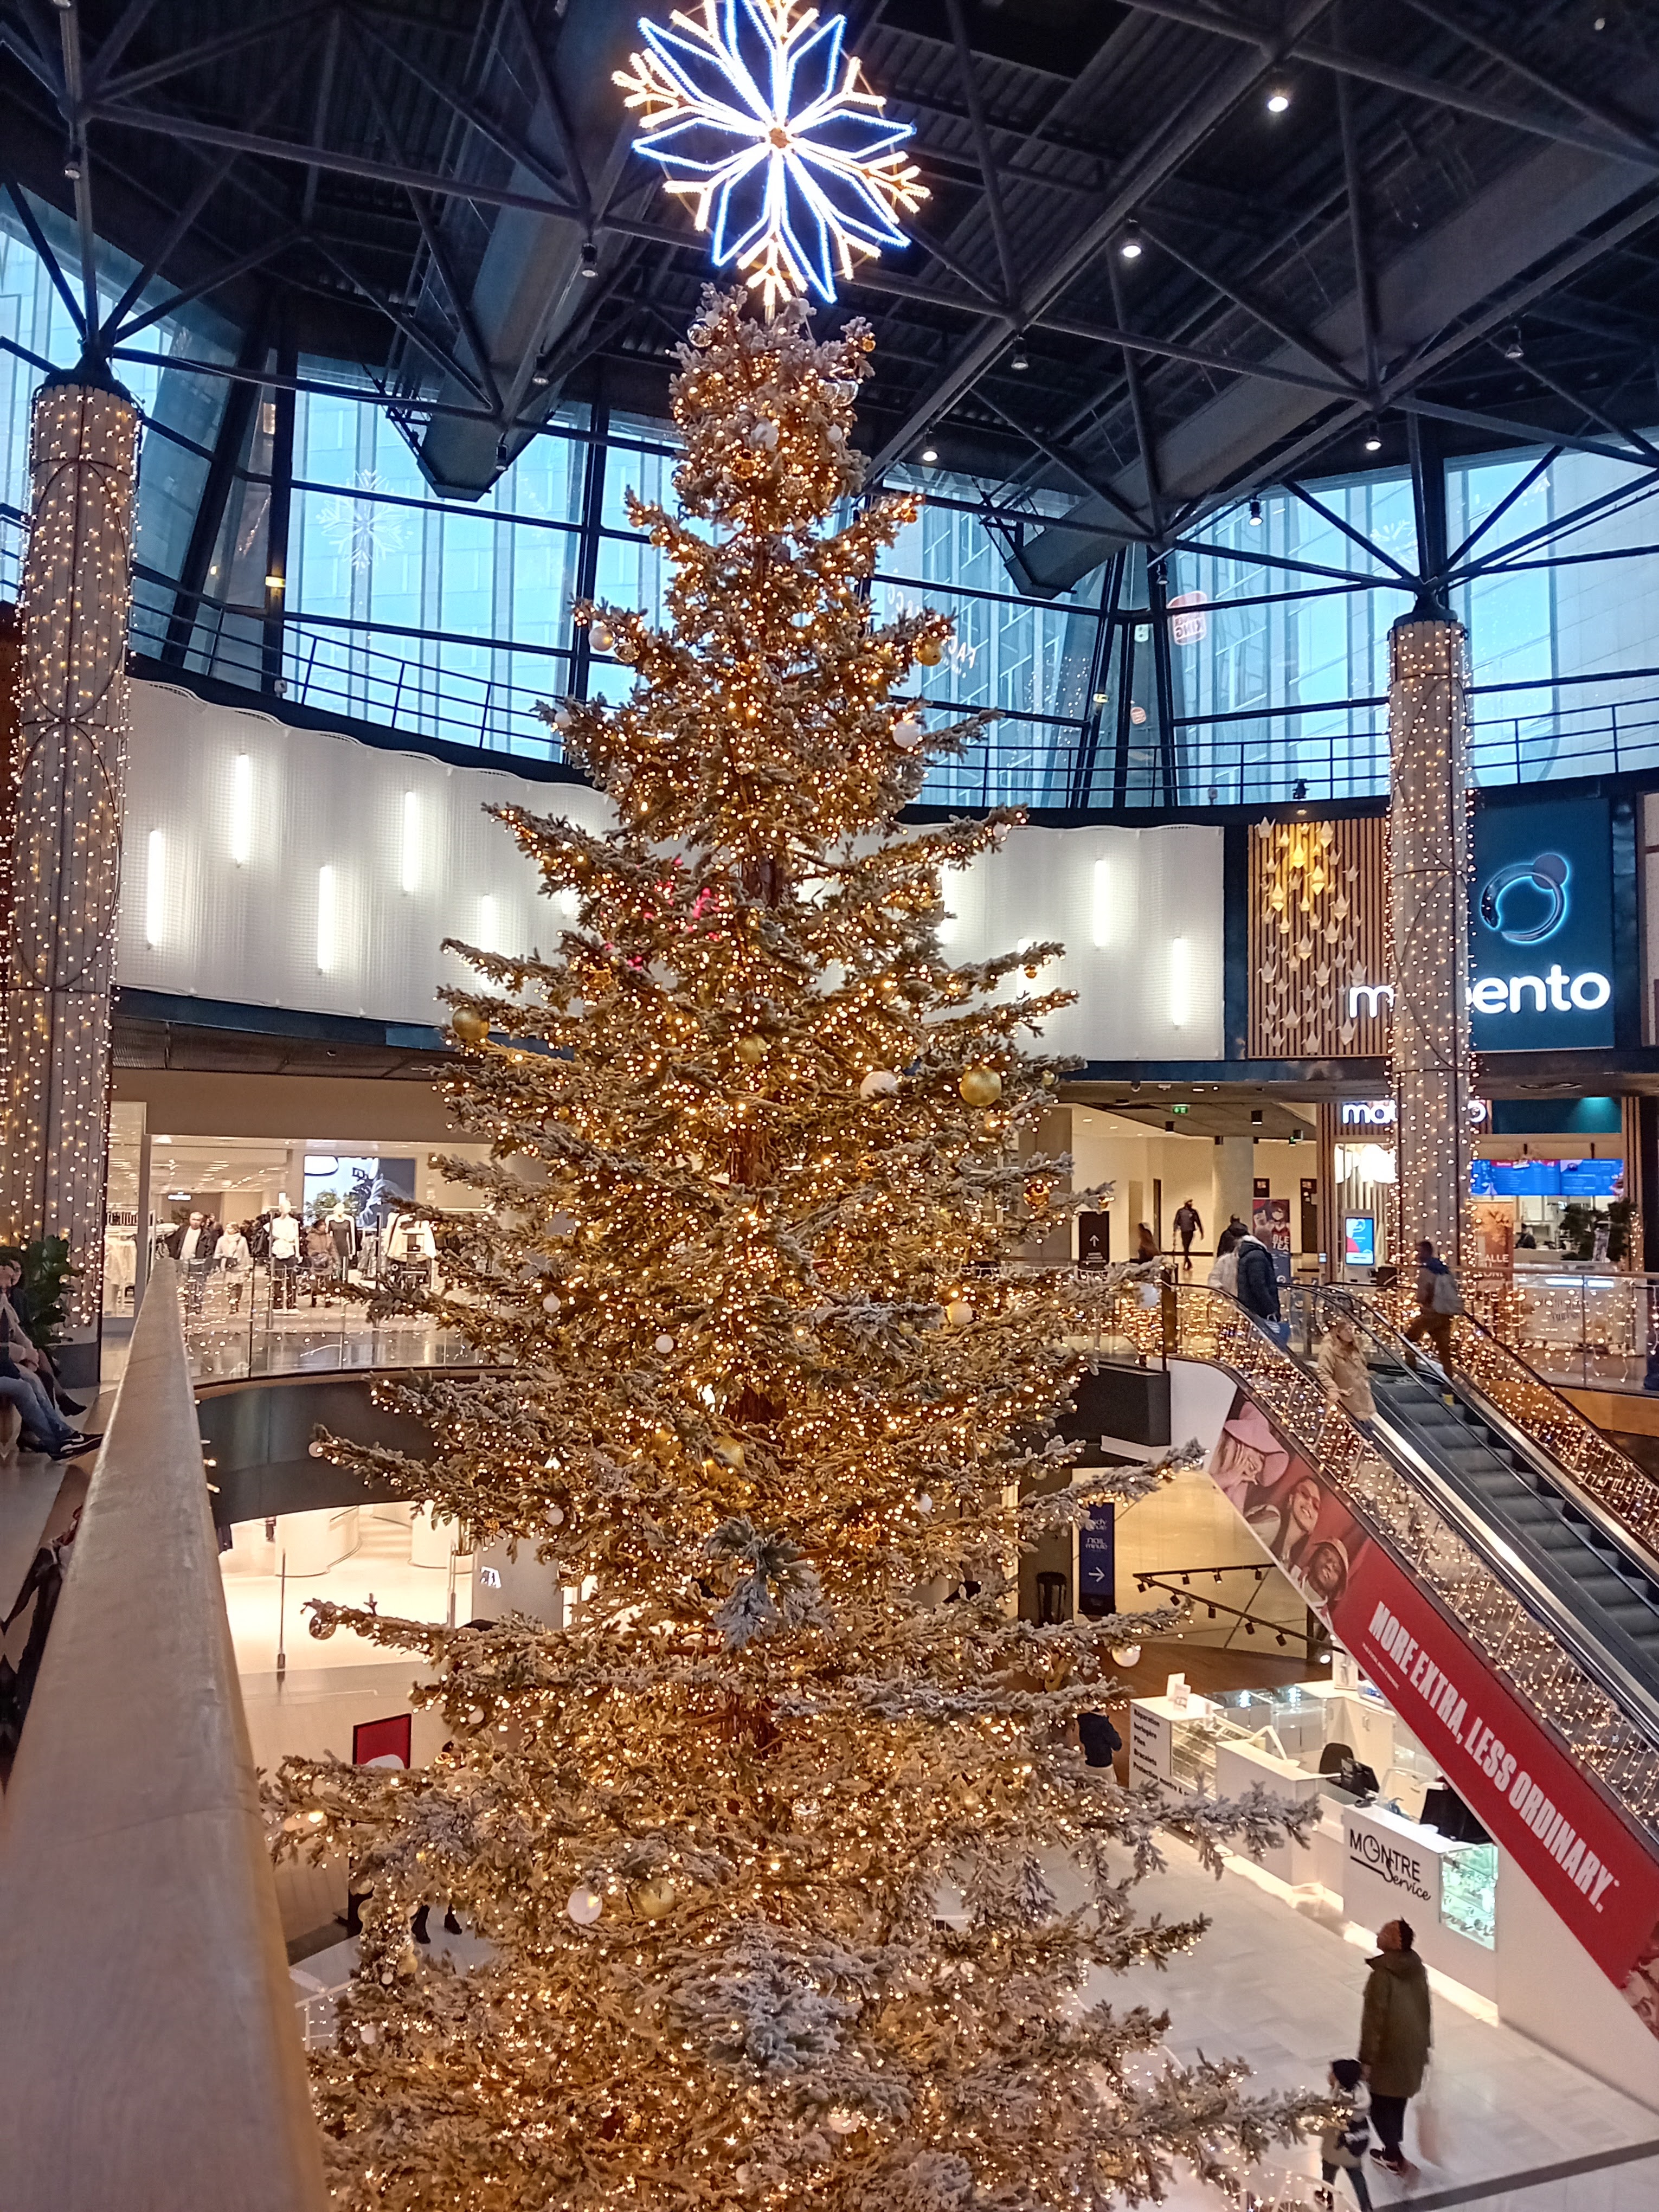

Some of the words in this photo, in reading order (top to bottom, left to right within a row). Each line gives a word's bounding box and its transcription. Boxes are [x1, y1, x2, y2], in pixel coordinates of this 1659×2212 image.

[1368, 1600, 1419, 1675] MORE
[1410, 1650, 1468, 1745] EXTRA,
[1464, 1716, 1517, 1792] LESS
[1350, 1829, 1421, 1882] MONTRE
[1382, 1858, 1432, 1901] Service
